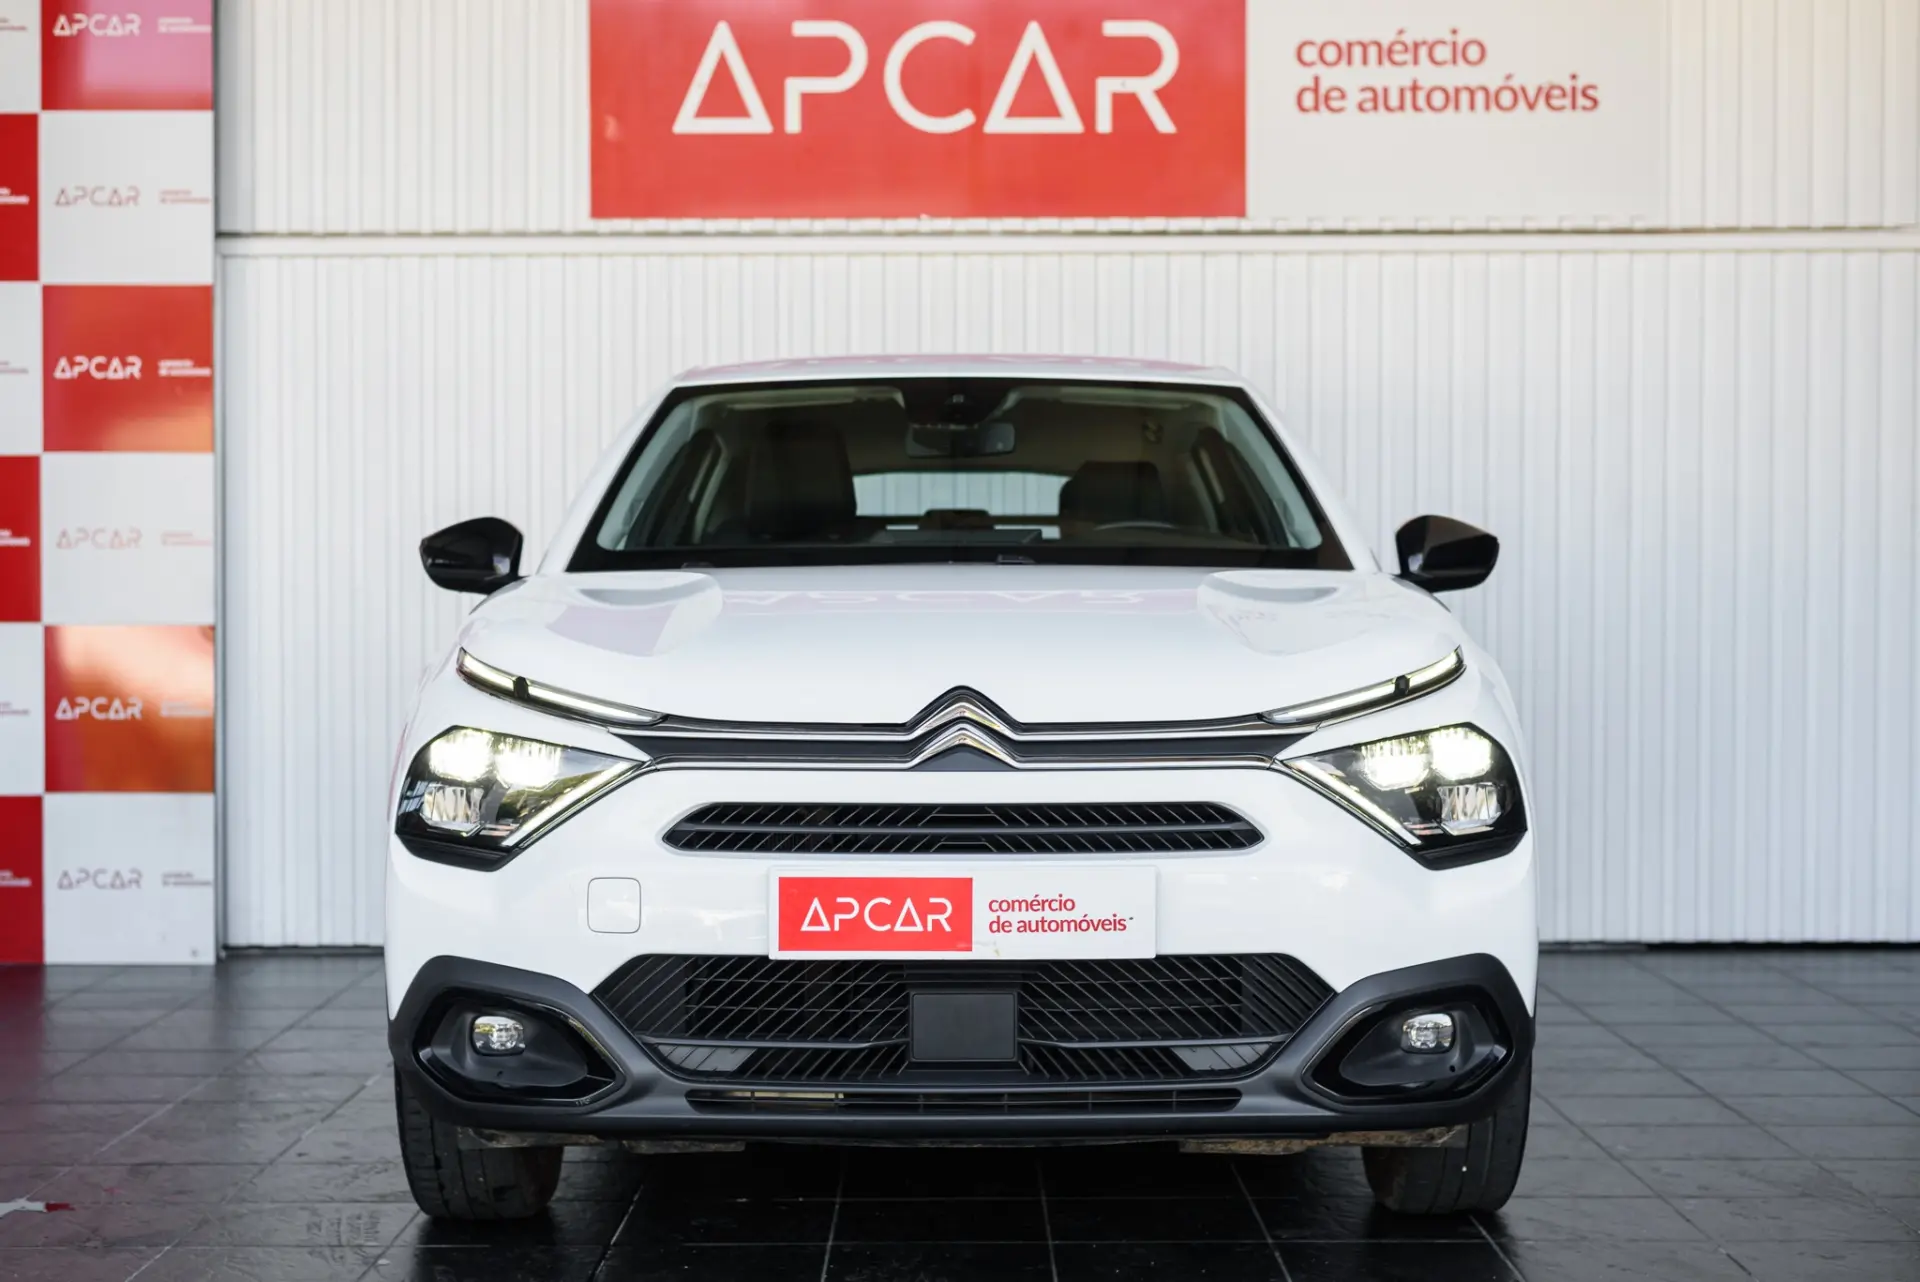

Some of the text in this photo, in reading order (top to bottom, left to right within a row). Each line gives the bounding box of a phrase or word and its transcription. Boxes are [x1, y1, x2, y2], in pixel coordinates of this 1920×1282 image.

[52, 13, 141, 37] APCAR
[1296, 28, 1487, 67] comércio
[672, 20, 1179, 134] APCAR
[1296, 73, 1600, 113] de automóveis
[54, 185, 141, 207] APCAR
[53, 355, 143, 380] APCAR
[55, 696, 144, 721] APCAR
[56, 867, 143, 890] APCAR
[800, 897, 952, 932] APCAR
[988, 893, 1076, 913] comércio
[988, 914, 1127, 933] de automóveis
